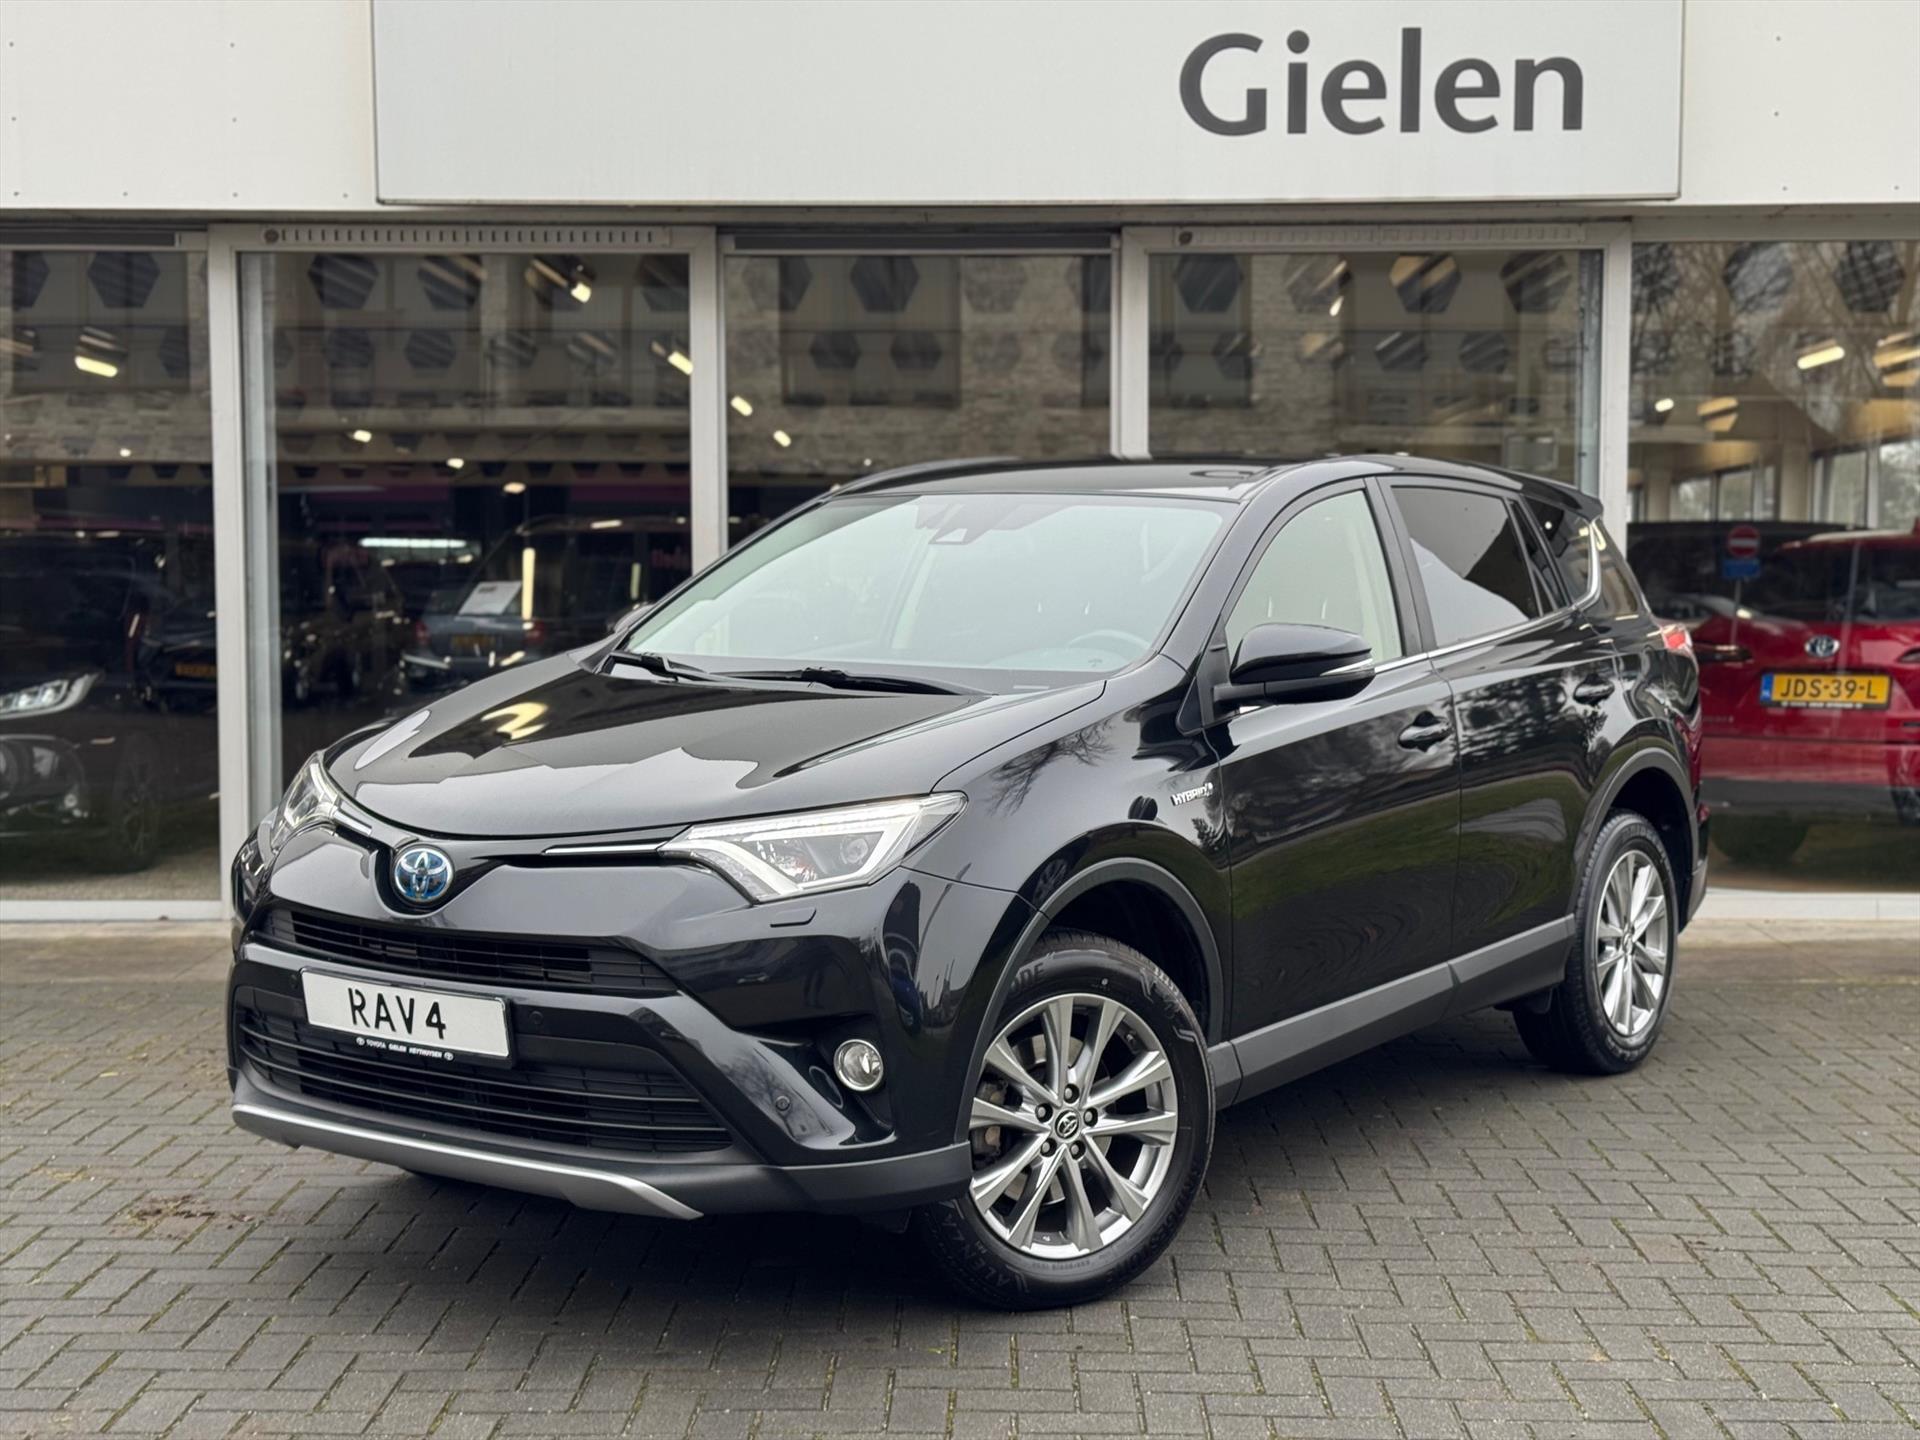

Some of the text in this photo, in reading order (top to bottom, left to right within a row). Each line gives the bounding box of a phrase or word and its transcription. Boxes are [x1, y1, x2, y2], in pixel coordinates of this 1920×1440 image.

[1179, 27, 1583, 136] Gielen
[1780, 678, 1878, 699] JDS-39-L
[1171, 785, 1208, 806] HYBRID
[348, 987, 446, 1039] RAV 4
[366, 1038, 386, 1049] TOYOTA
